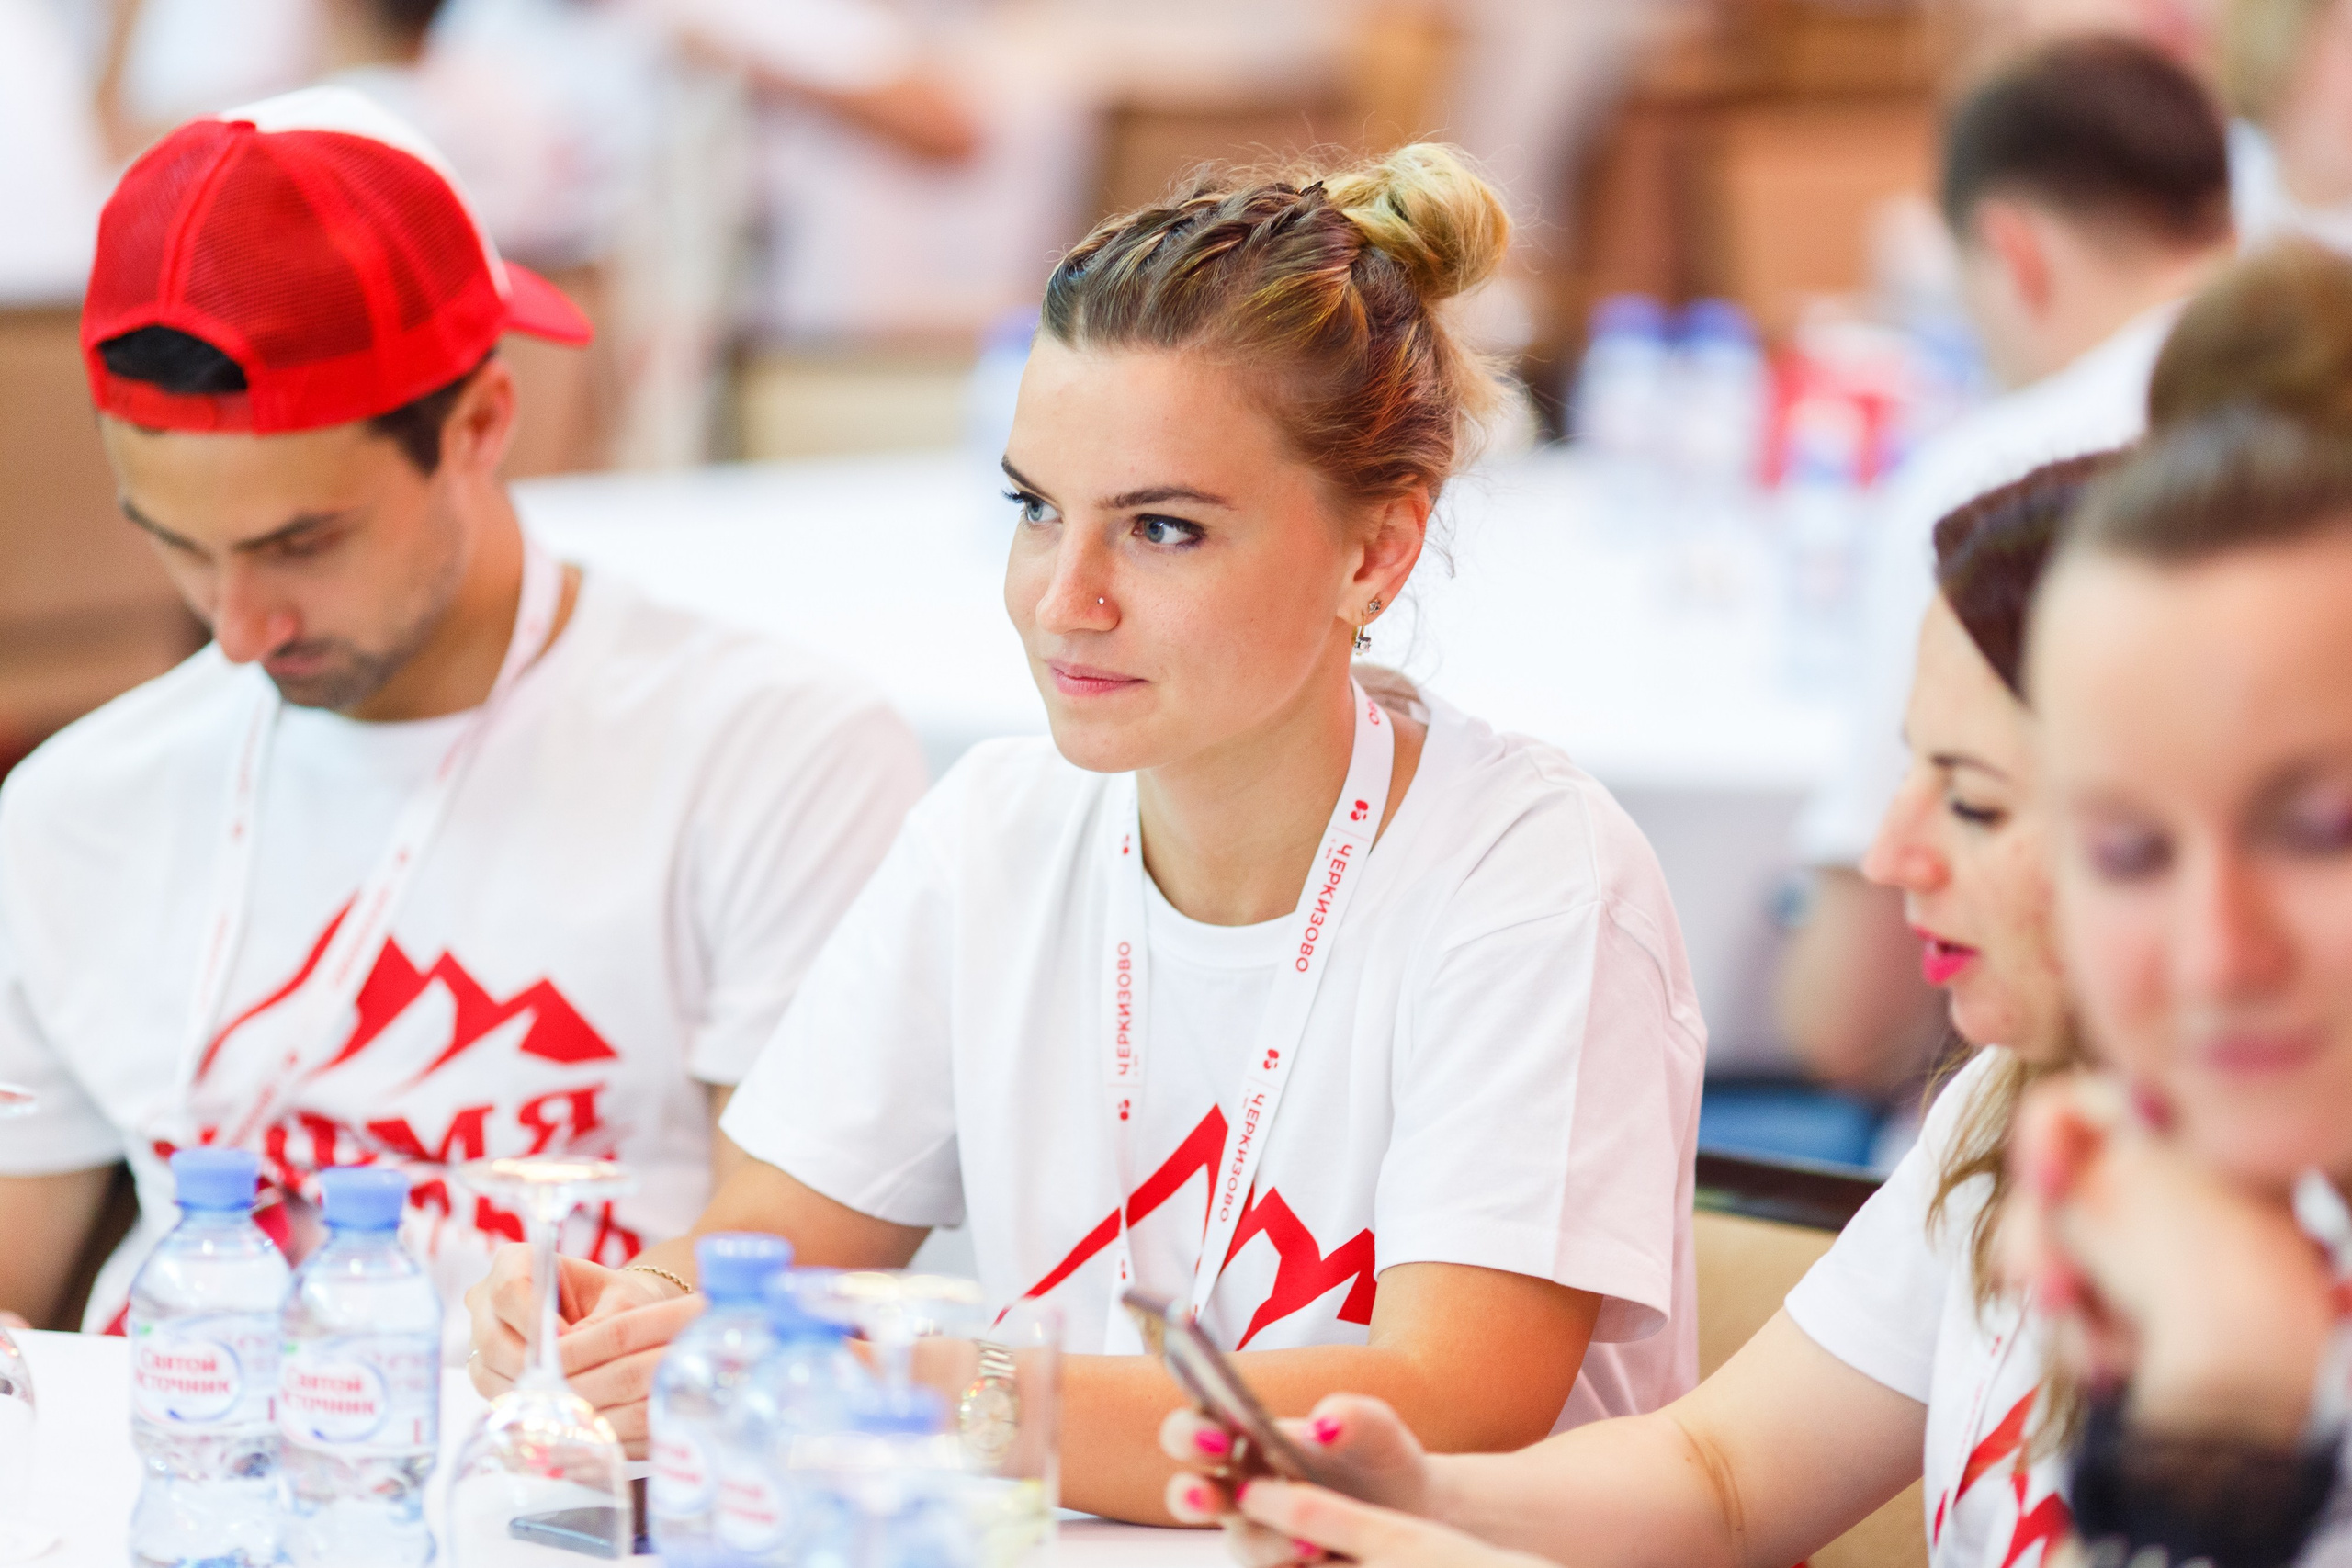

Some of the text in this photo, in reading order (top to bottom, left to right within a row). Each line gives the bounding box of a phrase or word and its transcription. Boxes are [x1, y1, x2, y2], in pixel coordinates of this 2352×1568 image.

[1295, 844, 1353, 973] ЧЕРКИЗОВО
[1116, 942, 1132, 1076] ЧЕРКИЗОВО
[1220, 1093, 1266, 1223] ЧЕРКИЗОВО
